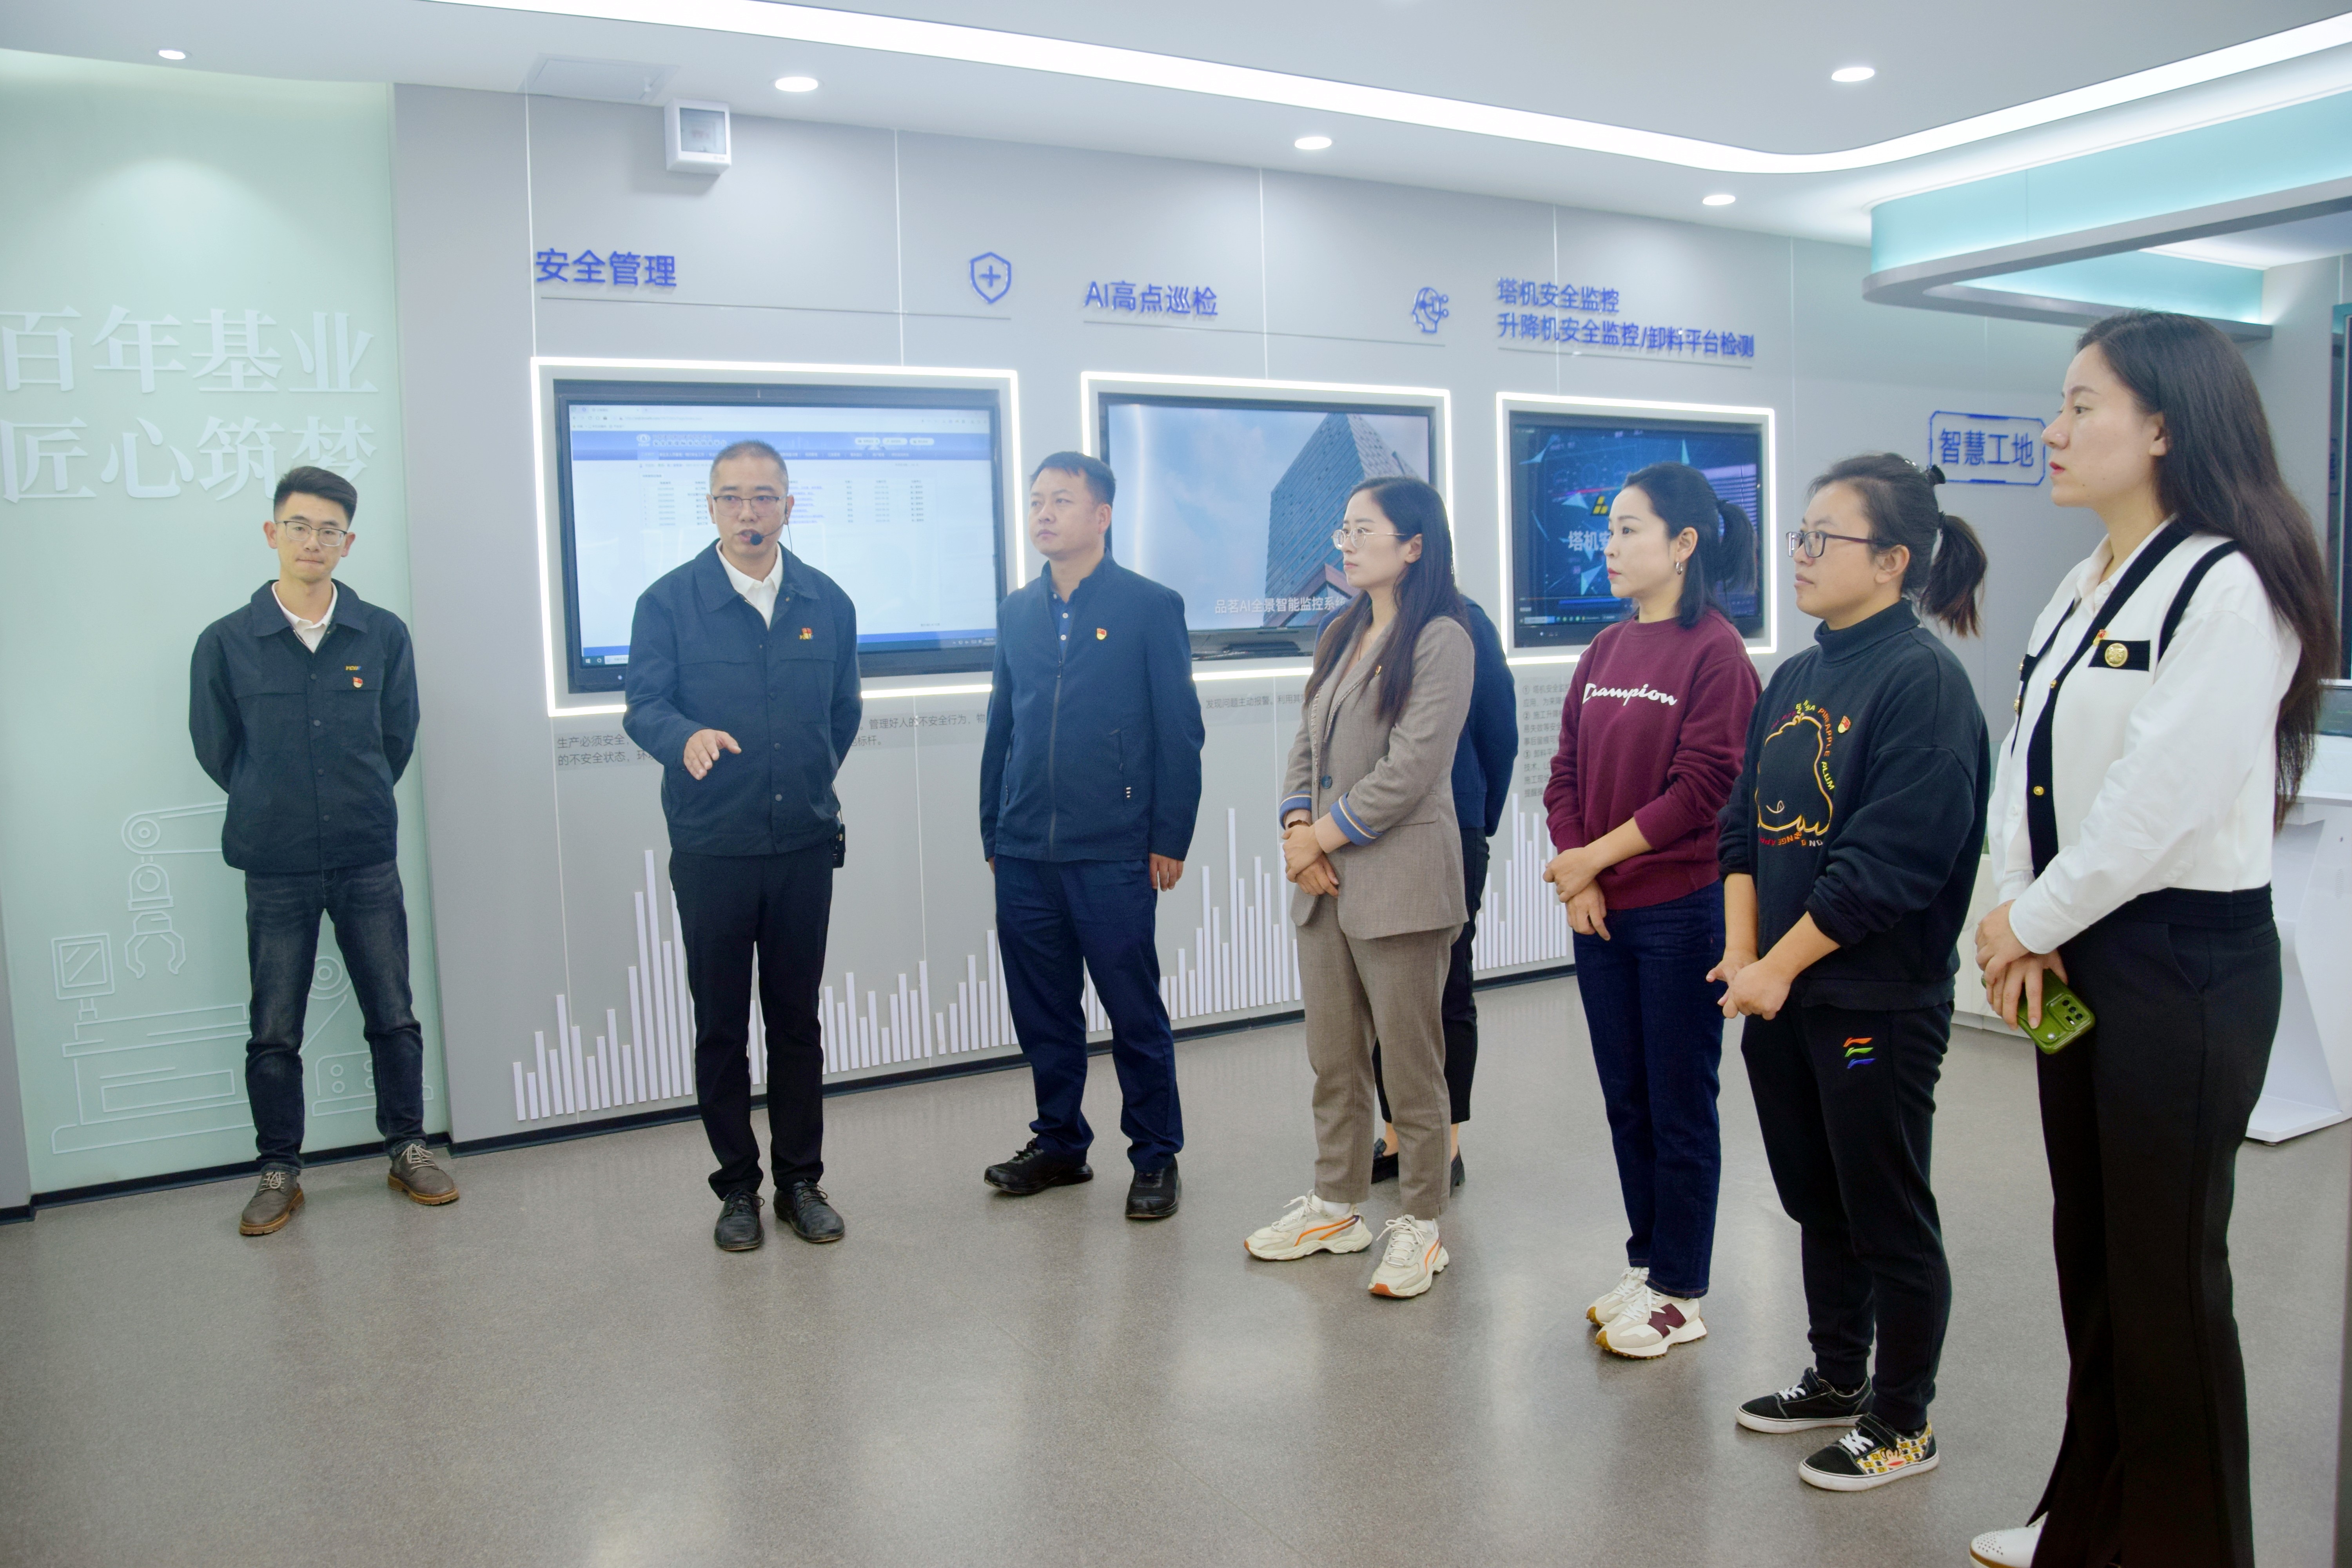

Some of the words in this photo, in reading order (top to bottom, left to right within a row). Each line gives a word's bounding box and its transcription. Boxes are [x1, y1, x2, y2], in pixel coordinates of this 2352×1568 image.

[535, 248, 677, 288] 安全管理
[1083, 280, 1218, 316] AI高点巡检
[1497, 277, 1620, 314] 塔机安全监控
[0, 304, 379, 394] 百年基业
[1497, 312, 1755, 358] 升降机安全监控/卸料平台检测
[1939, 428, 2034, 467] 智慧工地
[558, 749, 654, 766] 的不安全状态，环
